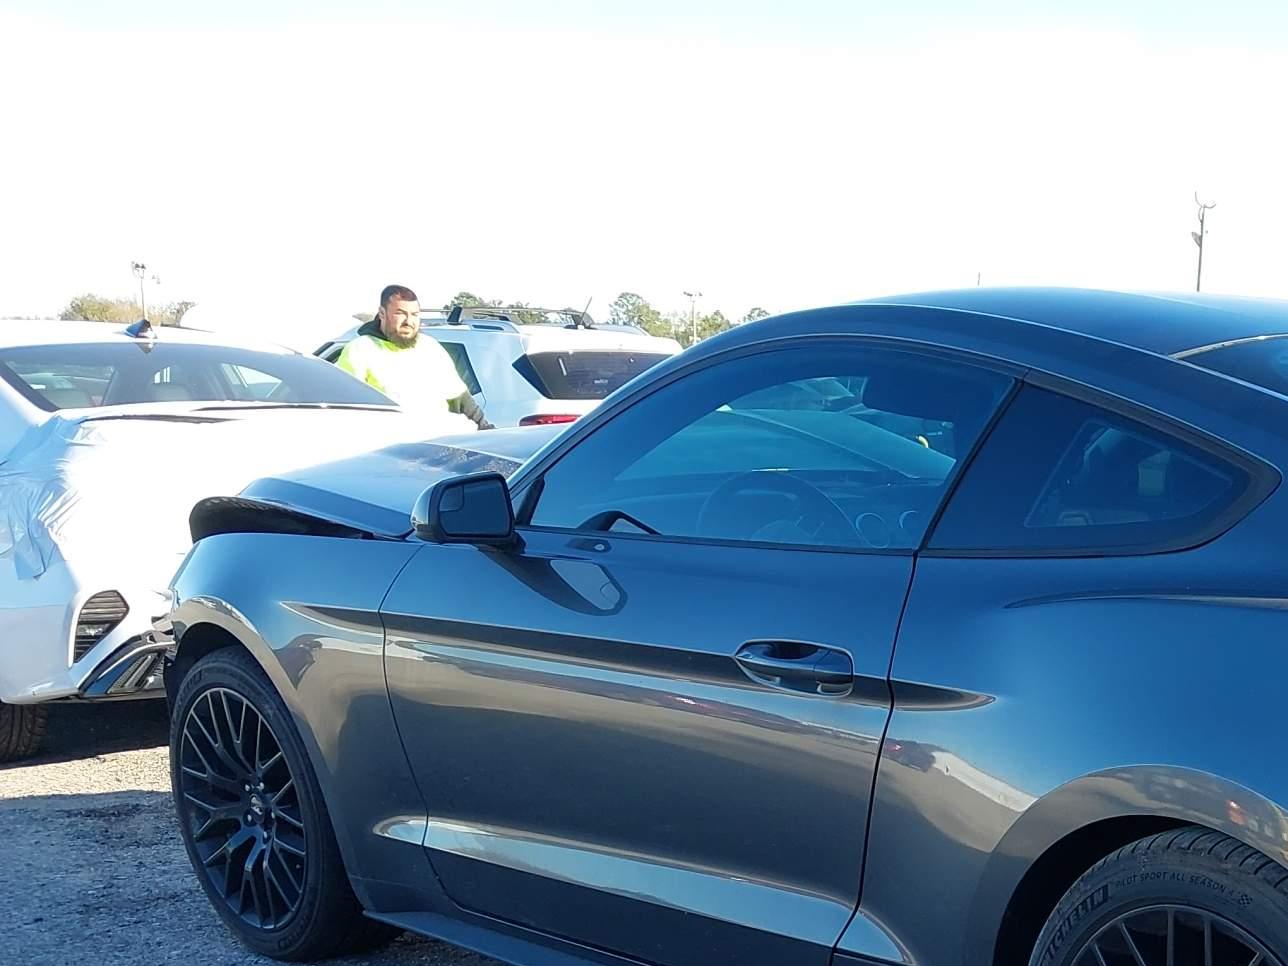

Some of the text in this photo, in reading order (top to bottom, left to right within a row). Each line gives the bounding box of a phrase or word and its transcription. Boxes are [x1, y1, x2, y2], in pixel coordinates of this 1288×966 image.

[1140, 871, 1168, 881] SPORT
[1169, 871, 1185, 881] ALL
[1189, 875, 1227, 893] SEASON
